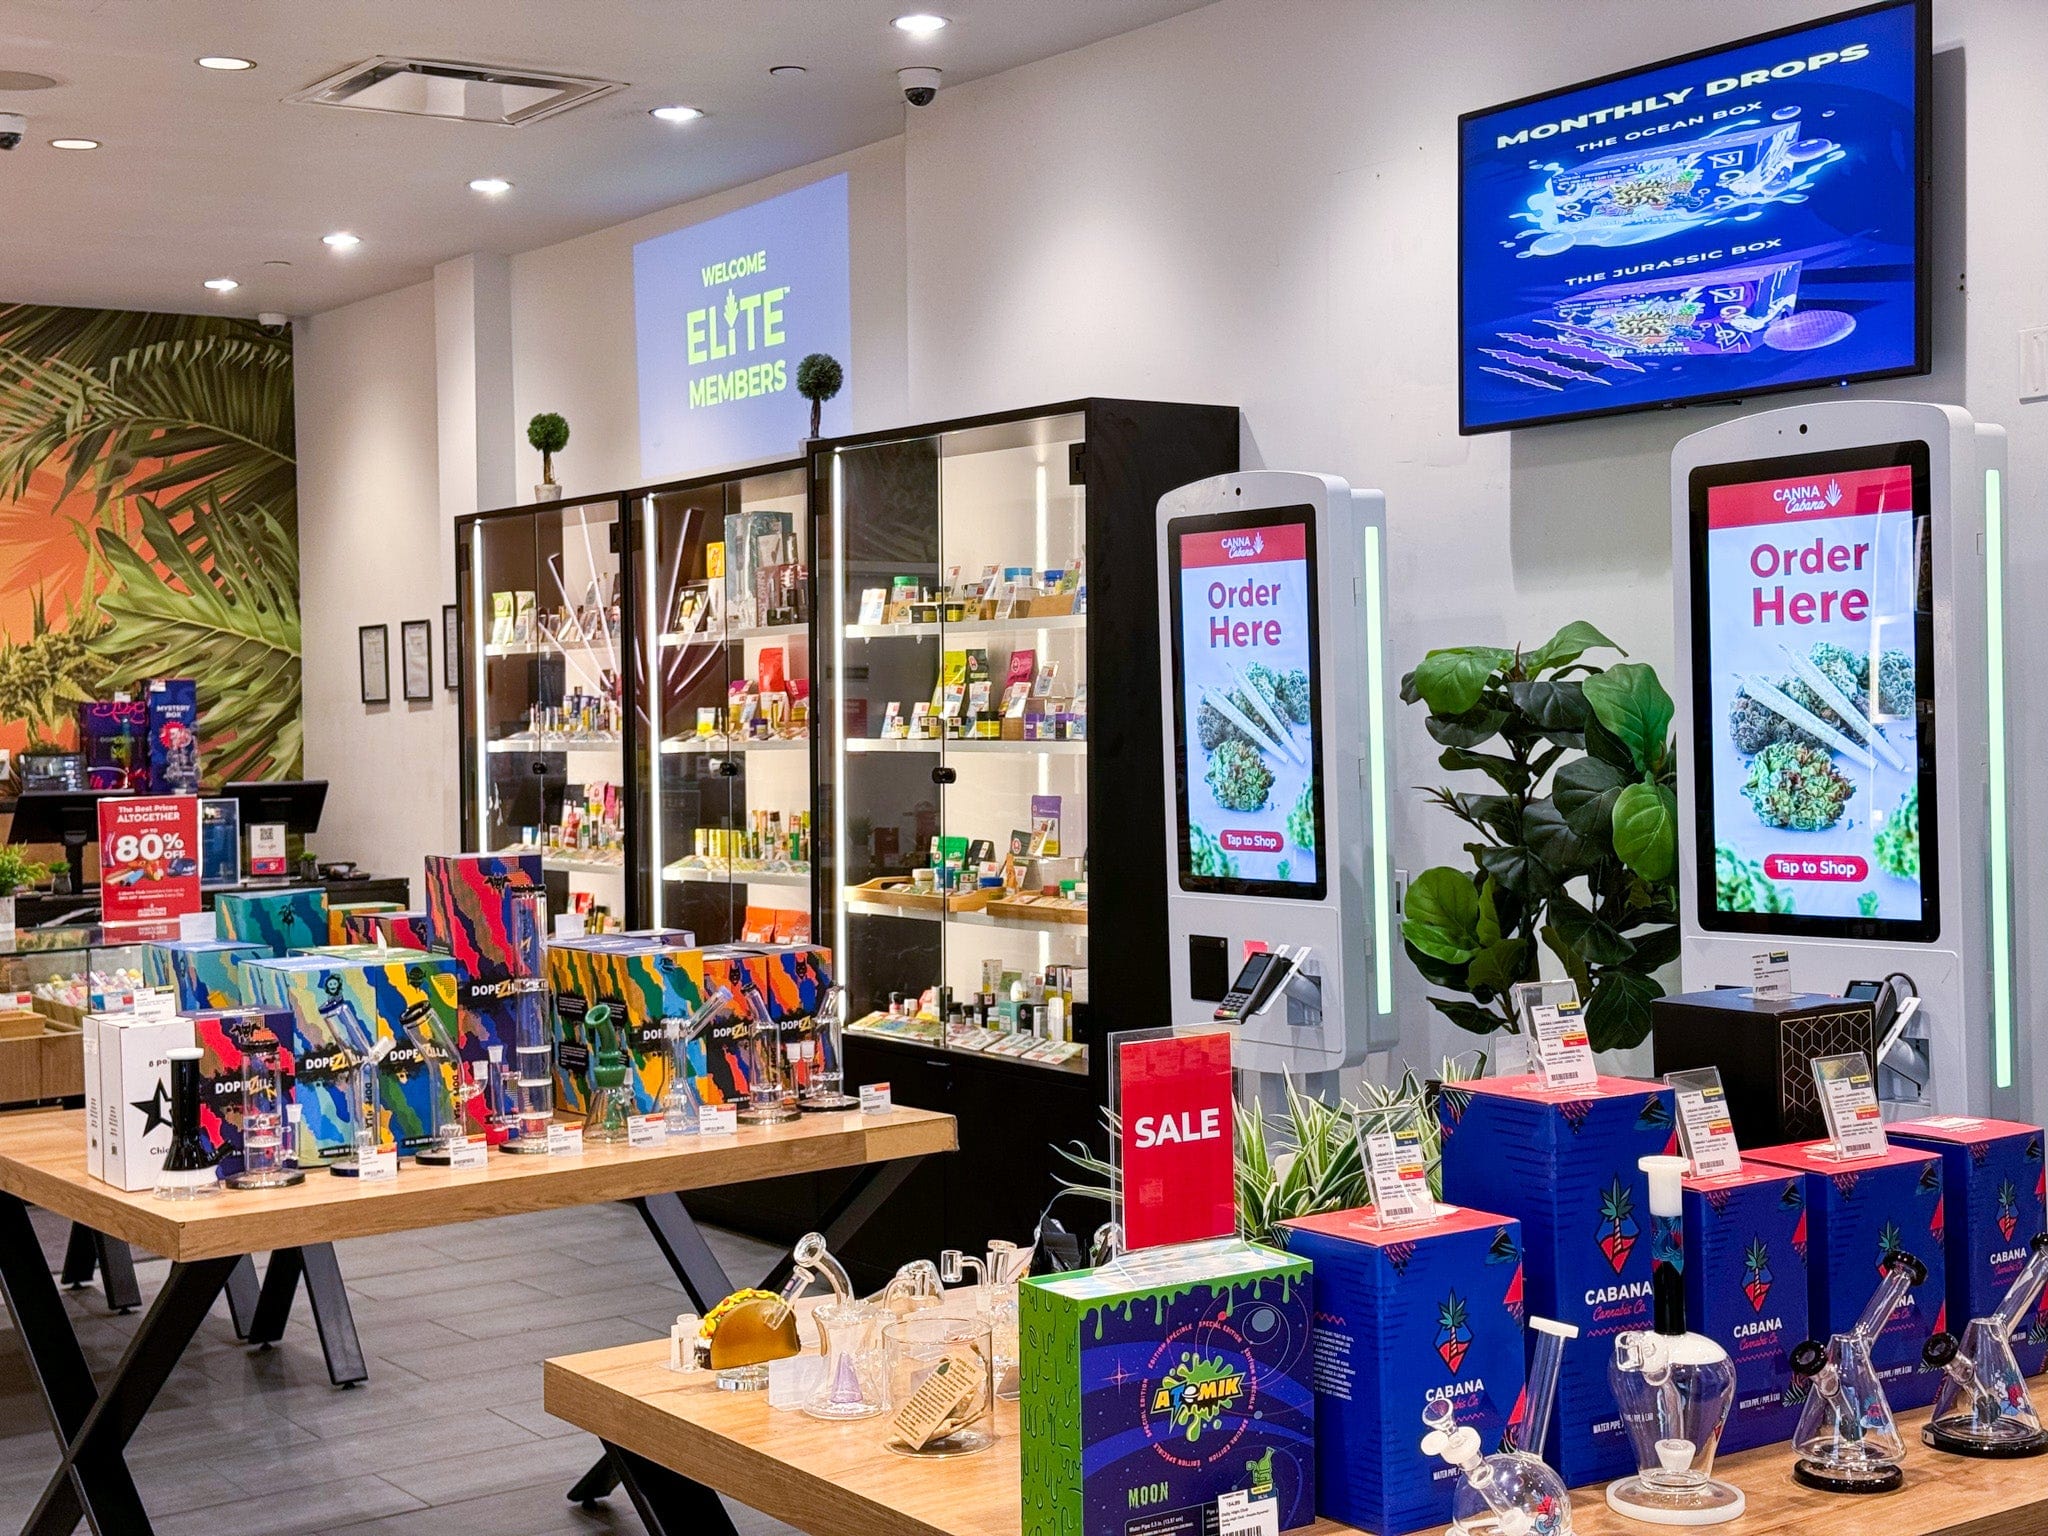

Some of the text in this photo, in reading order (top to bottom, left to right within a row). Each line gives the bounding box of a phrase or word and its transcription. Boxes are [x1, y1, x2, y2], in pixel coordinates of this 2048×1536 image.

[1497, 43, 1869, 149] MONTHLY DROPS
[1576, 101, 1762, 152] THE OCEAN BOX
[701, 250, 767, 288] WELCOME
[1565, 238, 1782, 287] THE JURASSIC BOX
[689, 359, 788, 410] MEMBERS
[1773, 485, 1821, 502] CANNA
[1785, 497, 1827, 514] Cabana
[1221, 536, 1251, 549] CANNA
[1750, 537, 1869, 578] Order
[1208, 578, 1281, 610] Order
[1753, 585, 1869, 627] Here
[1210, 615, 1282, 648] Here
[156, 704, 190, 712] MYSTERY
[117, 812, 180, 824] ALTOGETHER
[115, 833, 184, 863] 80%
[163, 850, 186, 859] OFF
[1226, 834, 1278, 849] Tap to Shop
[1775, 859, 1857, 878] Tap to Shop
[1134, 1107, 1221, 1149] SALE
[1990, 1247, 2027, 1265] CABANA
[1585, 1280, 1653, 1306] CABANA
[1593, 1299, 1647, 1322] Cannabis Co.
[1733, 1317, 1783, 1339] CABANA
[1154, 1377, 1241, 1410] ATOMIK
[1425, 1378, 1485, 1402] CABANA
[1128, 1481, 1169, 1511] MOON
